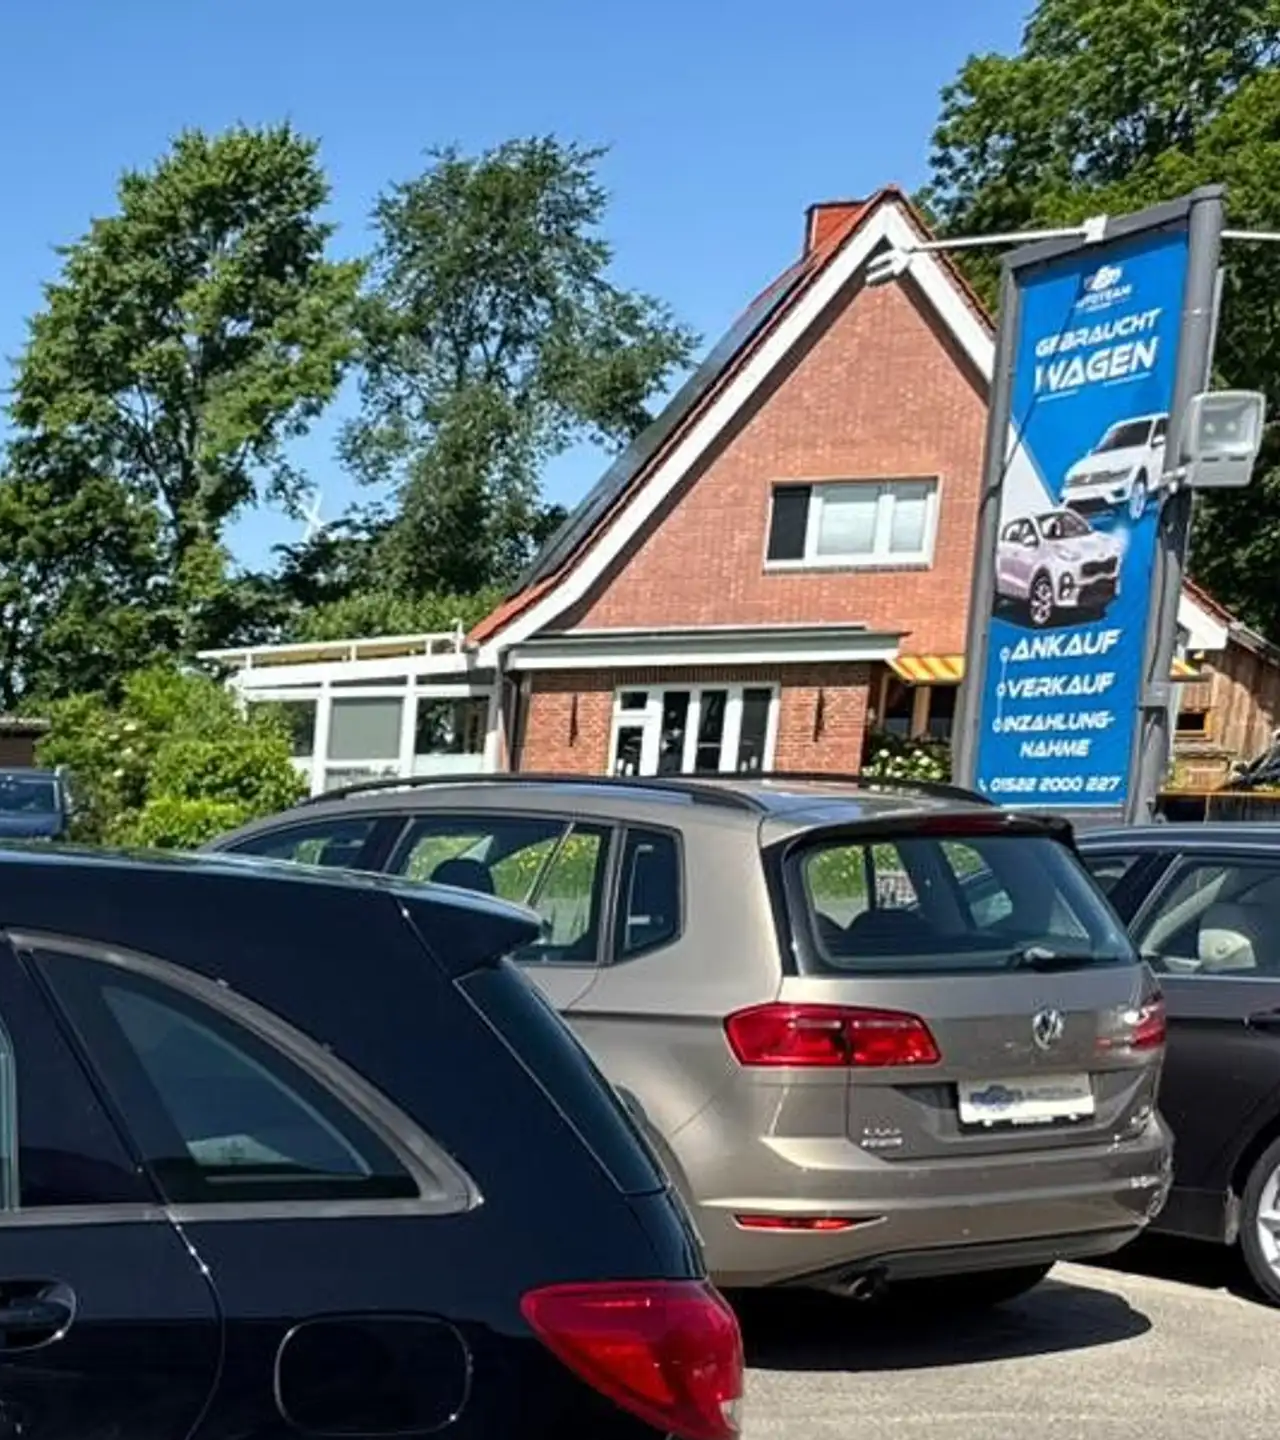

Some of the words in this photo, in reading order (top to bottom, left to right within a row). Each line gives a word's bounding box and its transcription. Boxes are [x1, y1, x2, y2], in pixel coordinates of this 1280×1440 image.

[1035, 307, 1163, 358] GEBRAUCHT
[1034, 336, 1159, 393] WAGEN
[1010, 629, 1123, 662] ANKAUF
[1007, 672, 1116, 699] VERKAUF
[1003, 710, 1116, 733] INZAHLUNG-
[1020, 739, 1091, 758] NAHME
[1039, 776, 1083, 792] 2000
